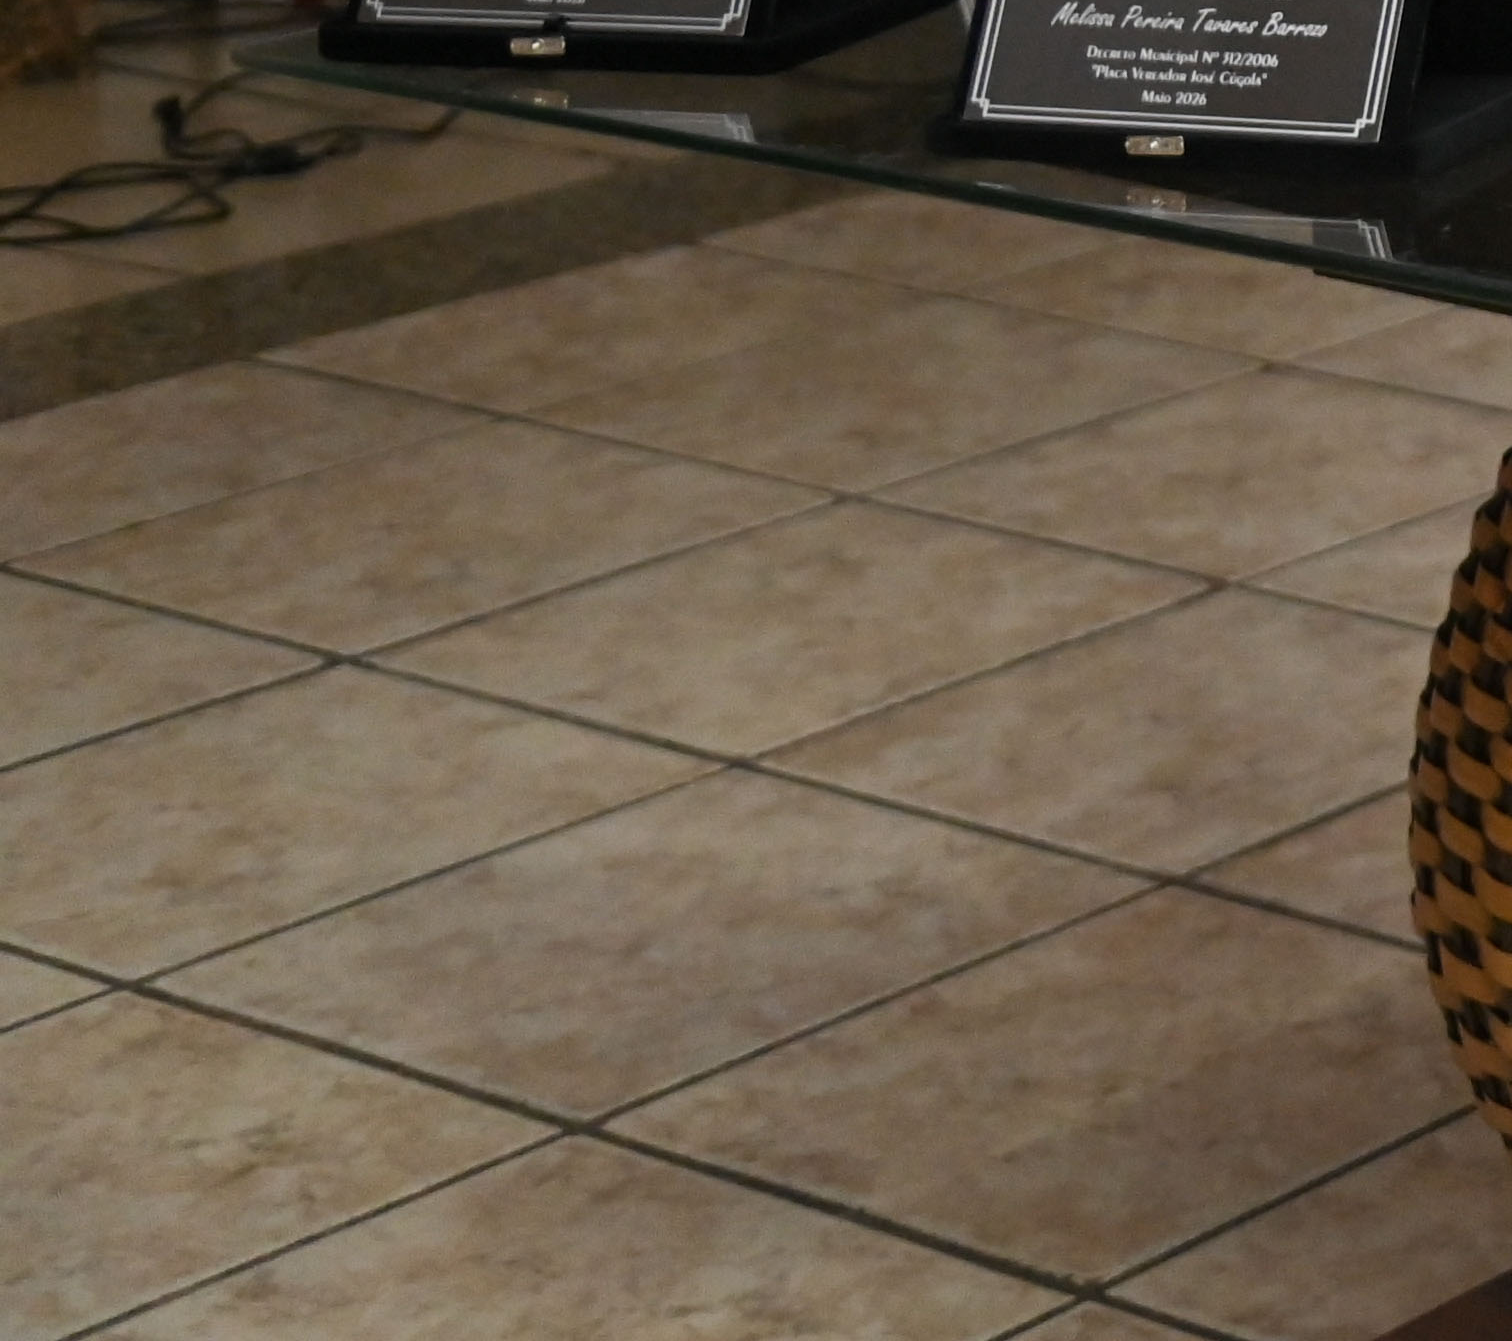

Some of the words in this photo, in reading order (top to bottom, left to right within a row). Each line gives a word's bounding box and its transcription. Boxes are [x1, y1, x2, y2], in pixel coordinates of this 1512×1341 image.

[1050, 1, 1115, 27] Melissa
[1120, 5, 1185, 31] Pereira
[1192, 8, 1259, 34] Tavares
